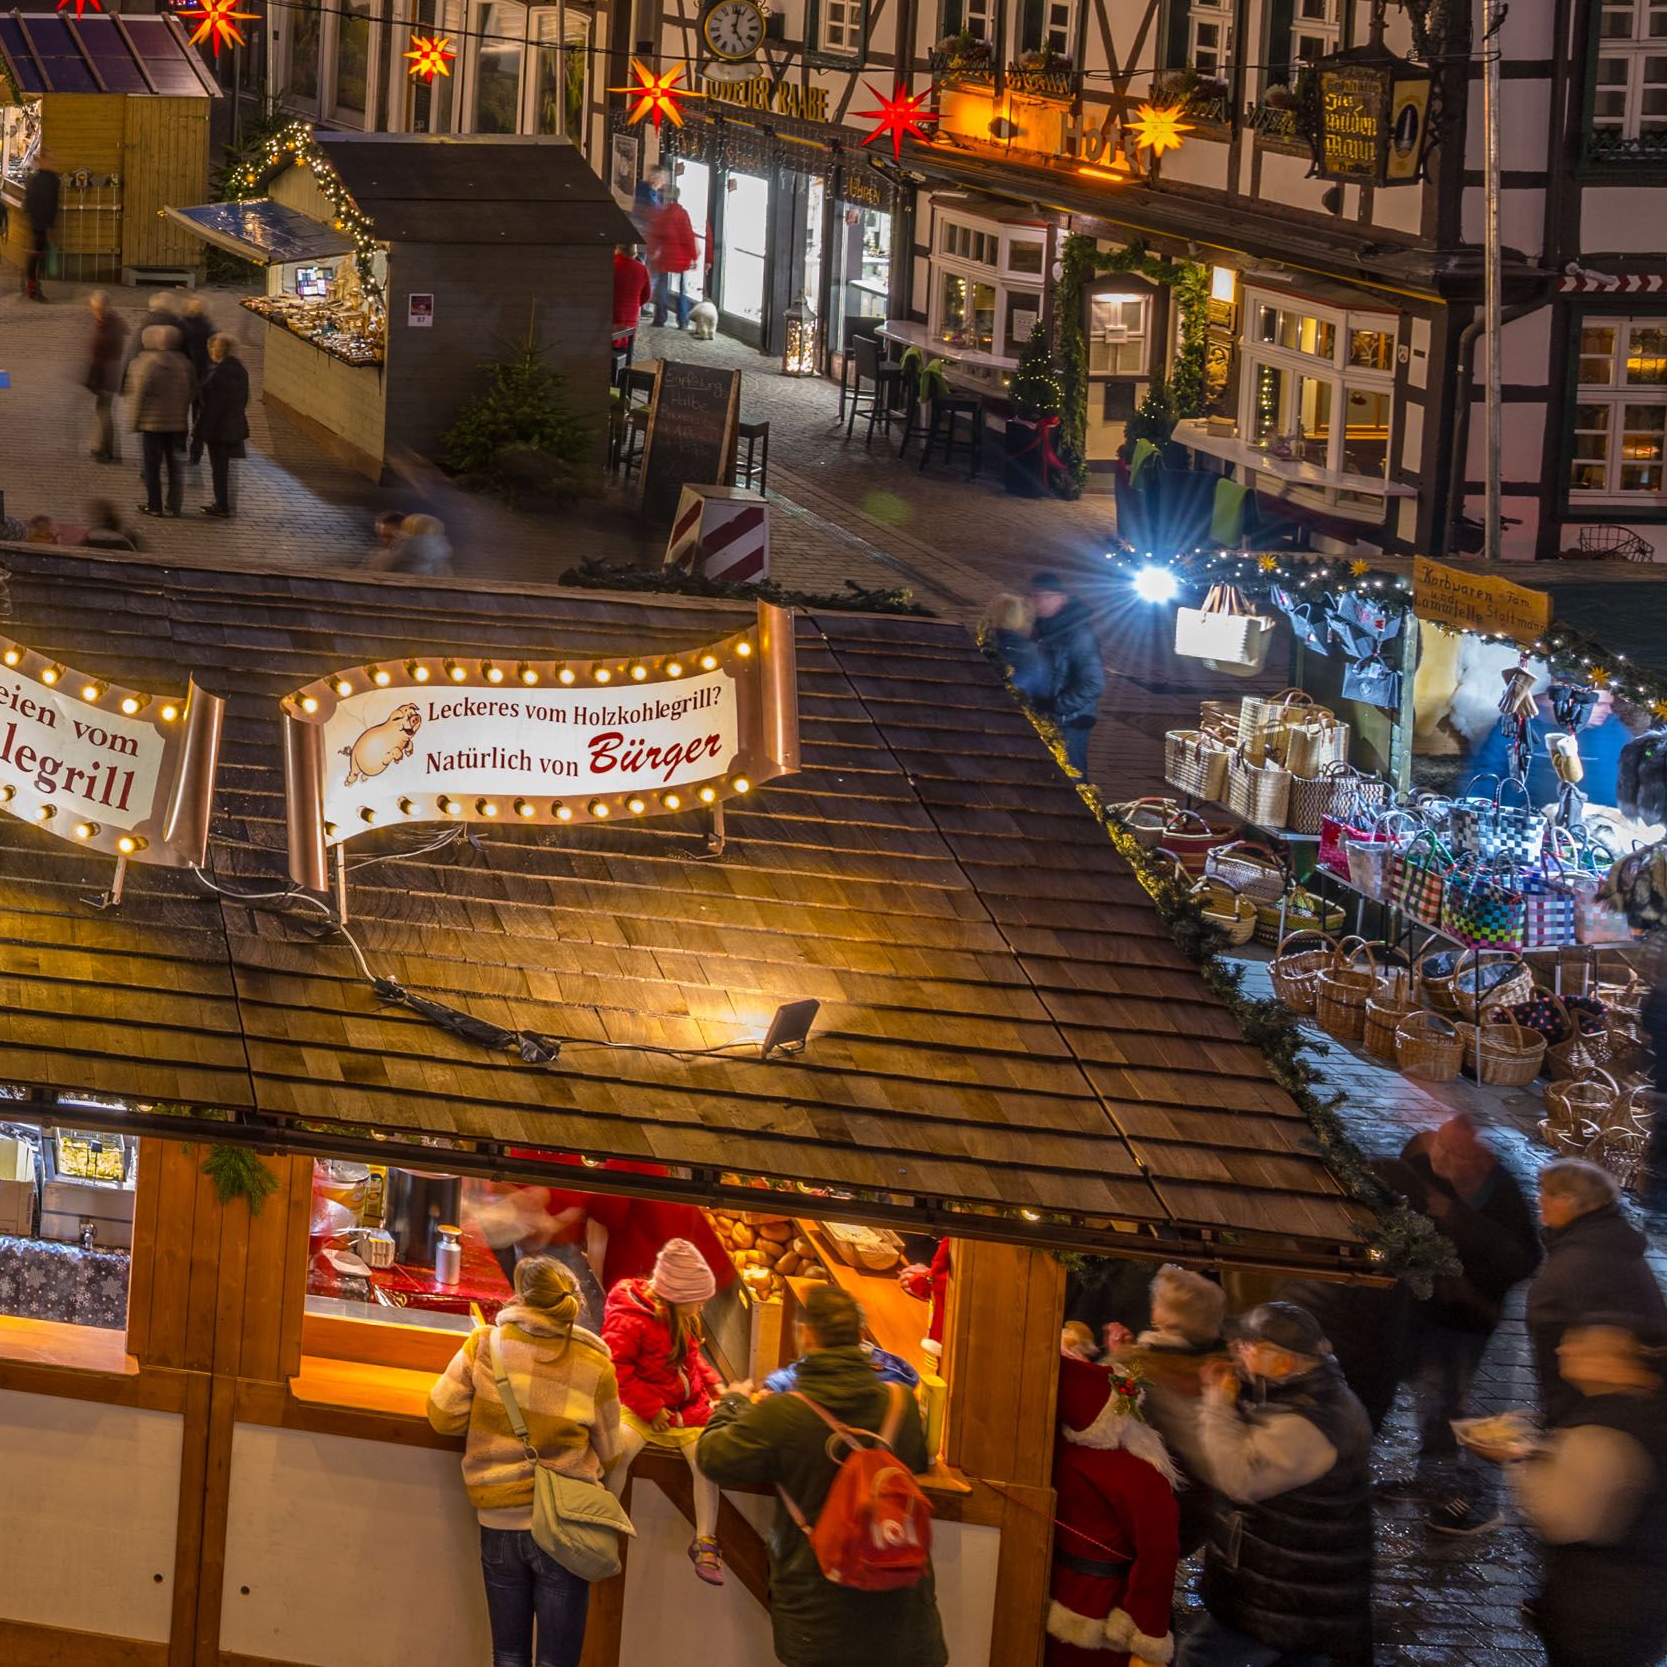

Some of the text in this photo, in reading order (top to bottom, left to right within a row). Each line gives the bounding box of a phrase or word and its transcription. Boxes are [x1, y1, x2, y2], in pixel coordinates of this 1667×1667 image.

[778, 80, 830, 124] RAABE
[428, 685, 723, 727] Leckeres vom Holzkohlegrill?
[72, 718, 139, 758] vom
[425, 730, 723, 783] Natürlich von Bürger
